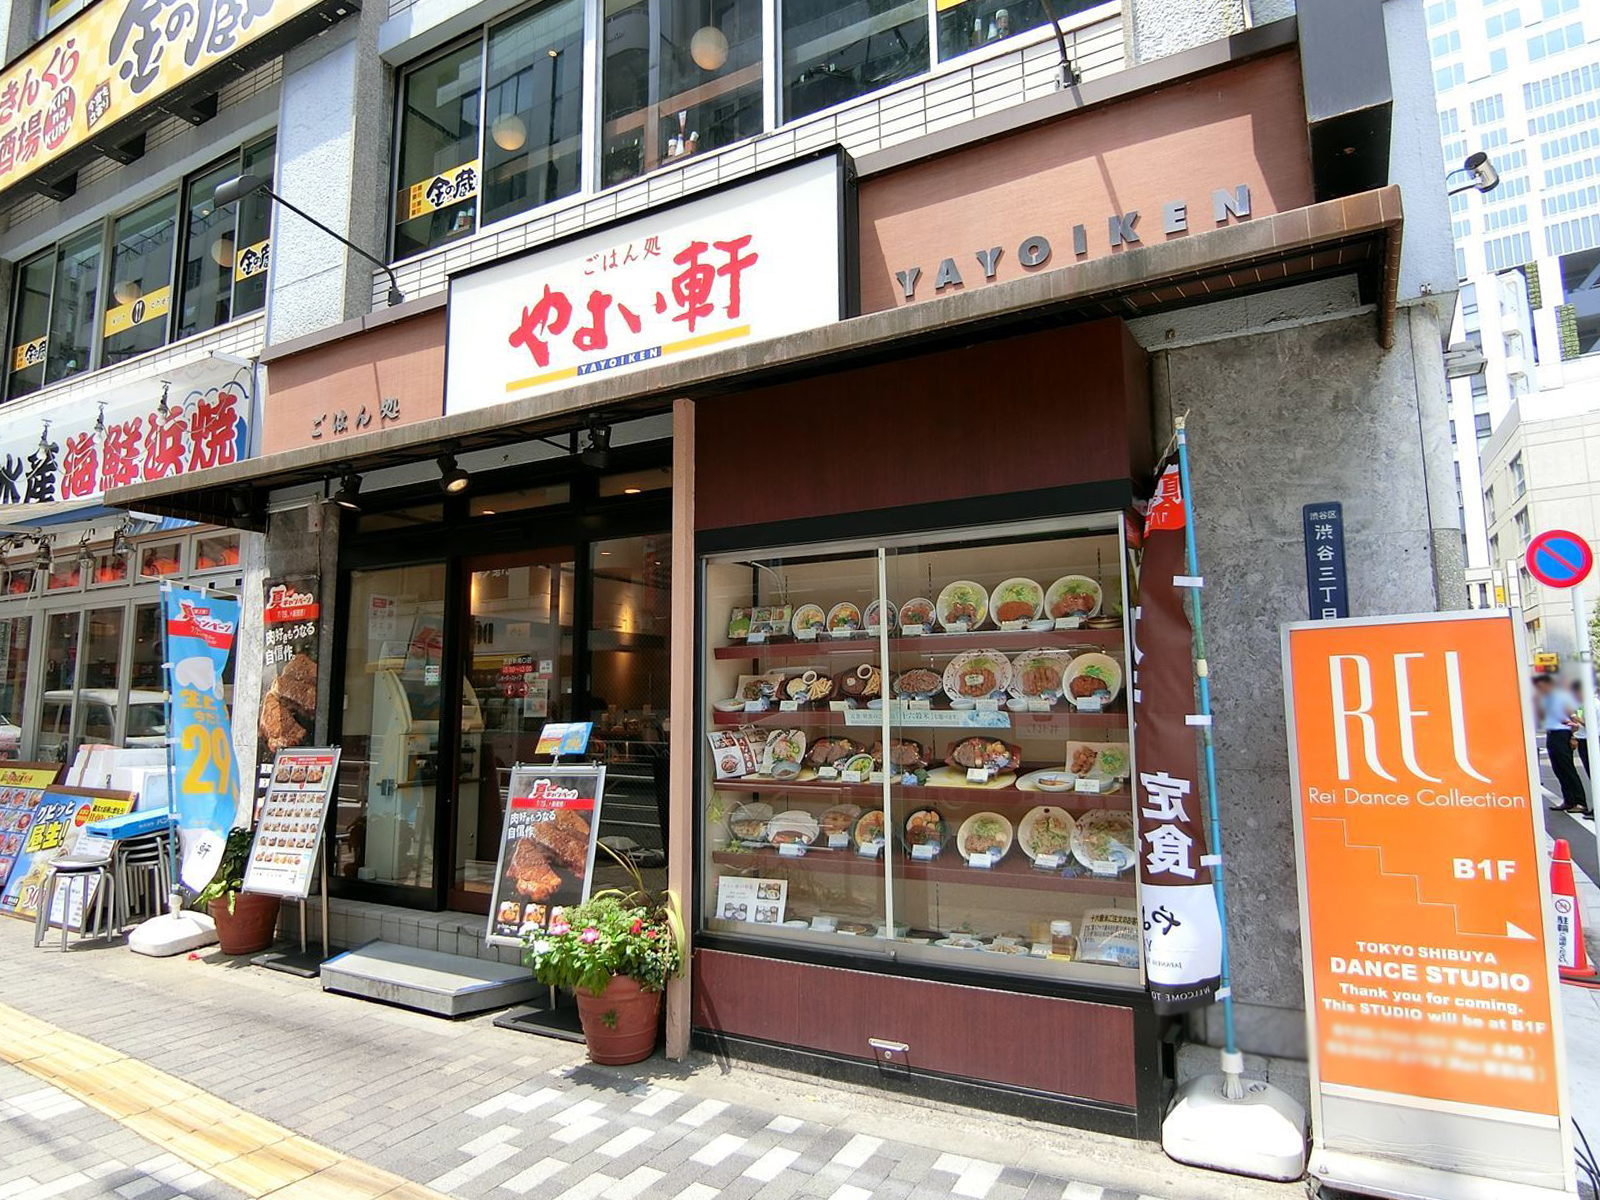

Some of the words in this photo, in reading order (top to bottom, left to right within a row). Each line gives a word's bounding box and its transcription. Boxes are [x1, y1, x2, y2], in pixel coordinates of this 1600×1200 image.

[584, 236, 660, 275] ごはん処
[896, 185, 1251, 297] YAYOIKEN
[508, 234, 758, 367] やよい軒
[580, 347, 661, 375] YAYOIKEN
[311, 398, 400, 438] ごはん処
[61, 391, 238, 499] 海鮮浜焼
[1310, 510, 1337, 520] 渋谷区
[1315, 524, 1337, 619] 渋谷三丁目
[1308, 787, 1336, 803] Rei
[1345, 787, 1410, 806] Dance
[1416, 788, 1526, 808] Collection
[1453, 858, 1516, 881] B1F
[1356, 941, 1414, 957] TOKYO
[1418, 948, 1497, 965] SHIBUYA
[1330, 957, 1418, 981] DANCE
[1426, 966, 1531, 992] STUDIO
[1322, 998, 1355, 1013] This
[1359, 1003, 1423, 1020] STUDIO
[1427, 1011, 1457, 1024] will
[1462, 1014, 1484, 1028] be
[1488, 1018, 1507, 1030] at
[1512, 1020, 1547, 1034] B1F
[1339, 983, 1388, 999] Thank
[1393, 991, 1421, 1005] you
[1426, 992, 1450, 1006] for
[1454, 998, 1524, 1016] coming.
